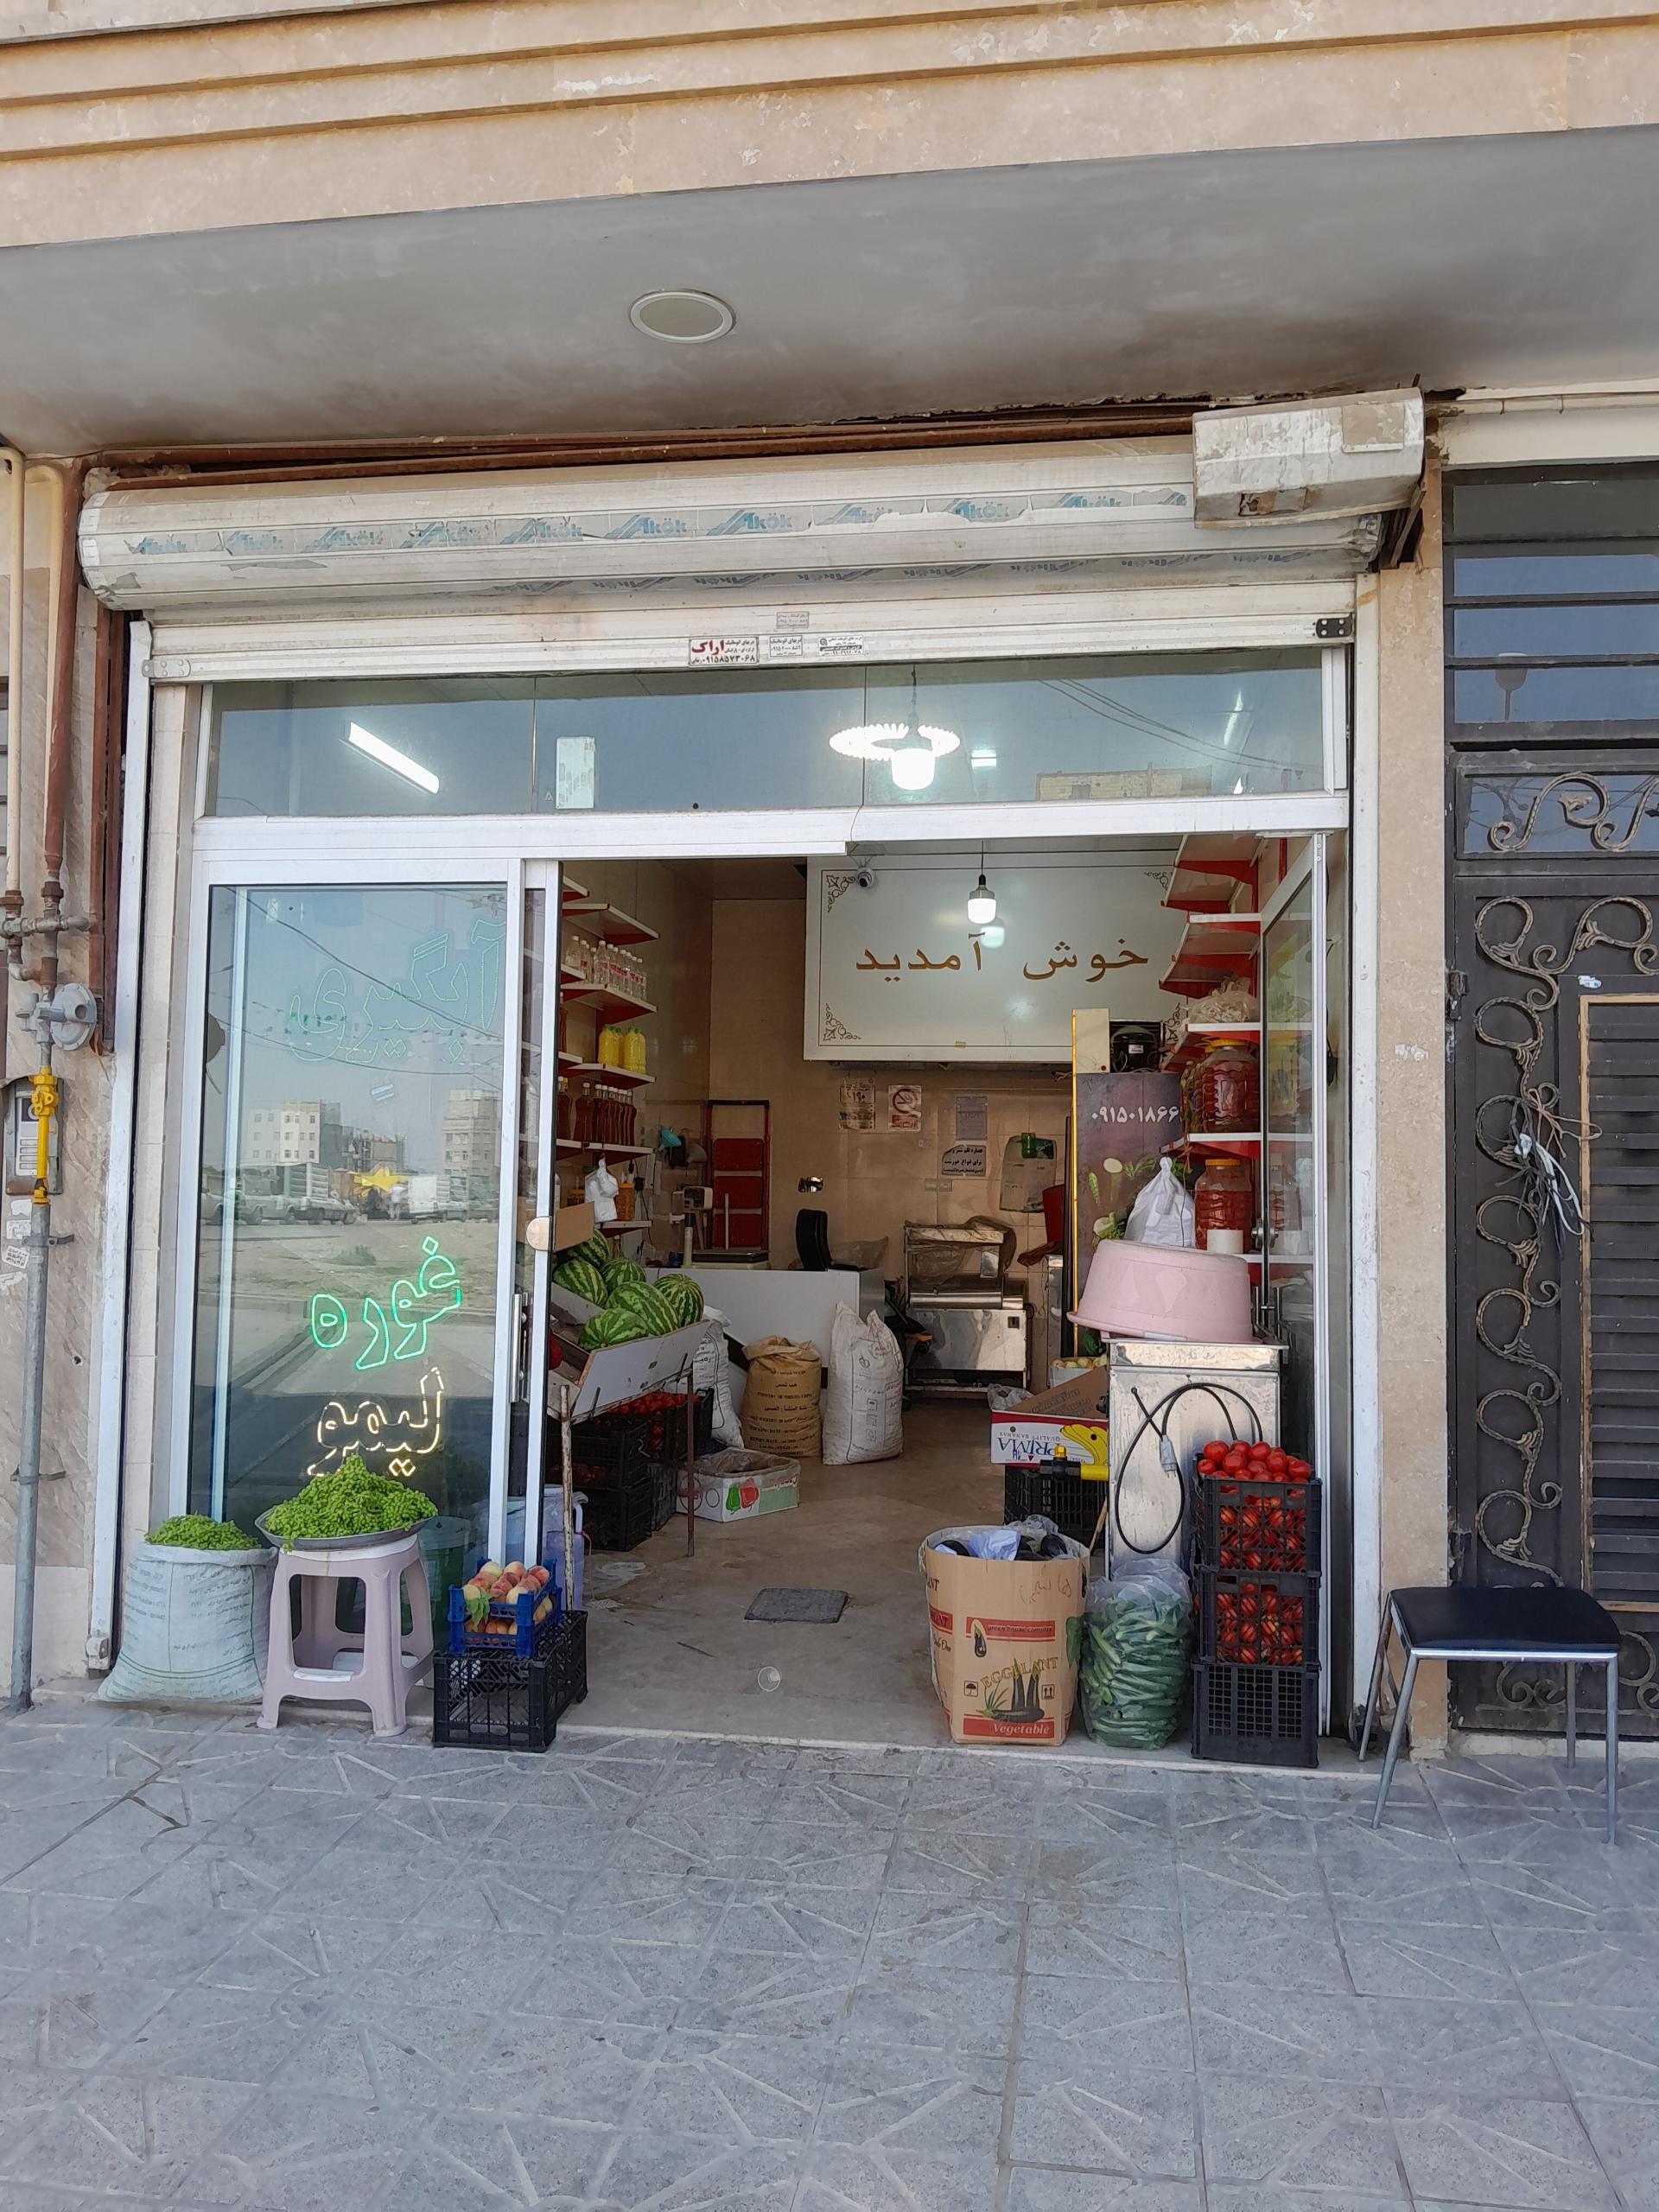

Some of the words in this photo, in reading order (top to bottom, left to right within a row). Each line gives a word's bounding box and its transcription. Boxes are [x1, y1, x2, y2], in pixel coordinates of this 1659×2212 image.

[691, 639, 725, 655] اراک
[855, 932, 987, 982] آمدید
[1022, 938, 1149, 982] خوش
[1091, 1105, 1183, 1123] ۰۹۱۵۰۱۸۶۶
[311, 1236, 461, 1370] غوره
[307, 1366, 445, 1477] لیمو
[998, 1437, 1057, 1457] PRIMA
[987, 1624, 1006, 1632] green
[979, 1656, 1058, 1688] EGGPLANT
[993, 1721, 1050, 1737] Vegetable
